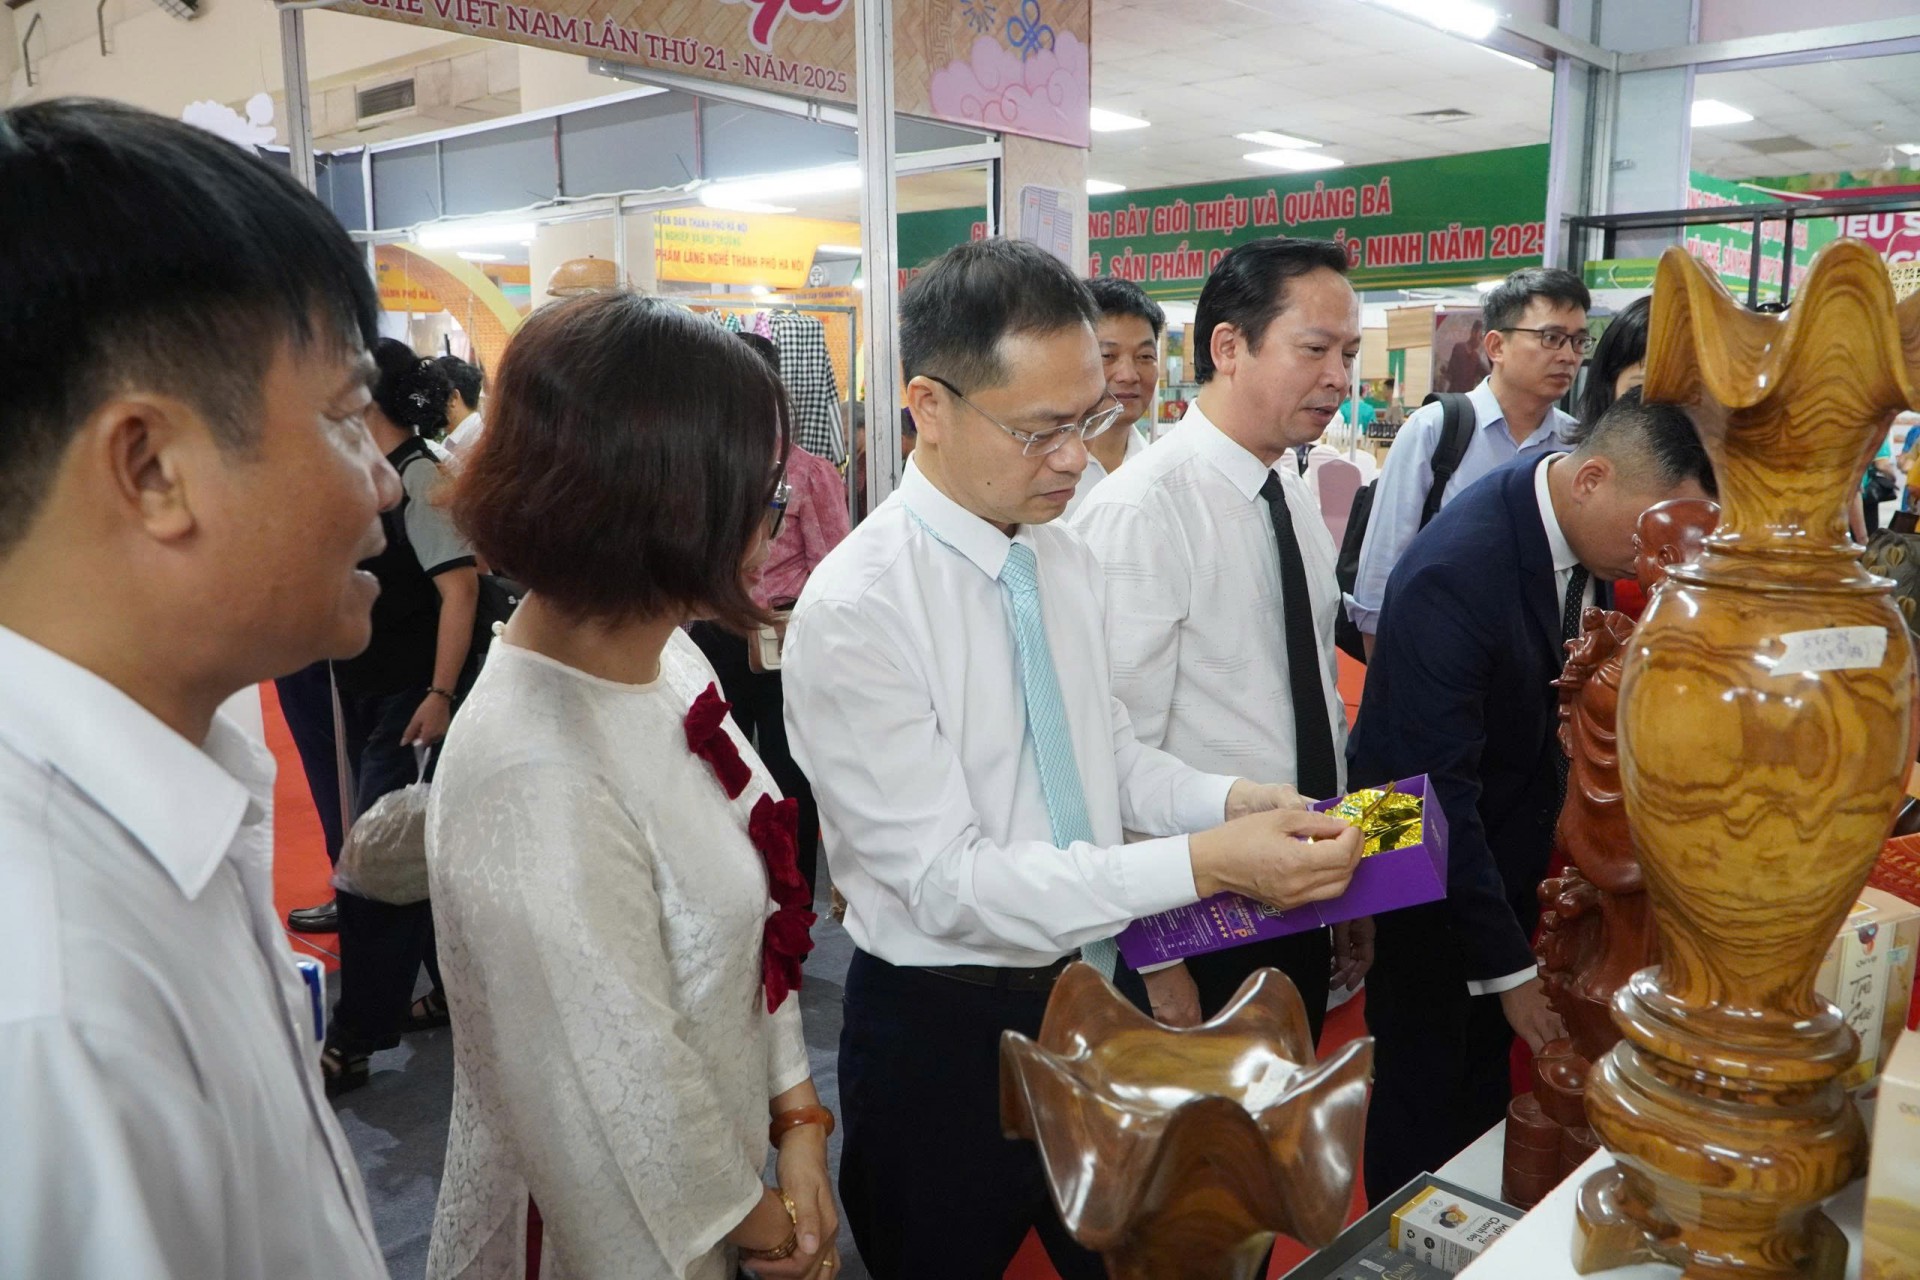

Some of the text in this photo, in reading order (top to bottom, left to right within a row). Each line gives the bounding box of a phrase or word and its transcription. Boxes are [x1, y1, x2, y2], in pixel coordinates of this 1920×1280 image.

[506, 5, 578, 43] NAM
[583, 19, 639, 55] LẦN
[645, 34, 699, 65] THỨ
[704, 46, 727, 71] 21
[744, 53, 799, 84] NĂM
[803, 66, 848, 93] 2025
[1115, 203, 1148, 236] BÀY
[1153, 198, 1190, 235] GIỚI
[1195, 194, 1248, 235] THIỆU
[1253, 189, 1278, 227] VÀ
[1284, 181, 1356, 225] QUẢNG
[1361, 177, 1392, 216] BÁ
[1111, 246, 1147, 281] SẢN
[1151, 240, 1204, 280] PHẨM
[1366, 233, 1423, 267] NINH
[1428, 223, 1485, 264] NĂM
[1476, 1217, 1500, 1233] Chanh
